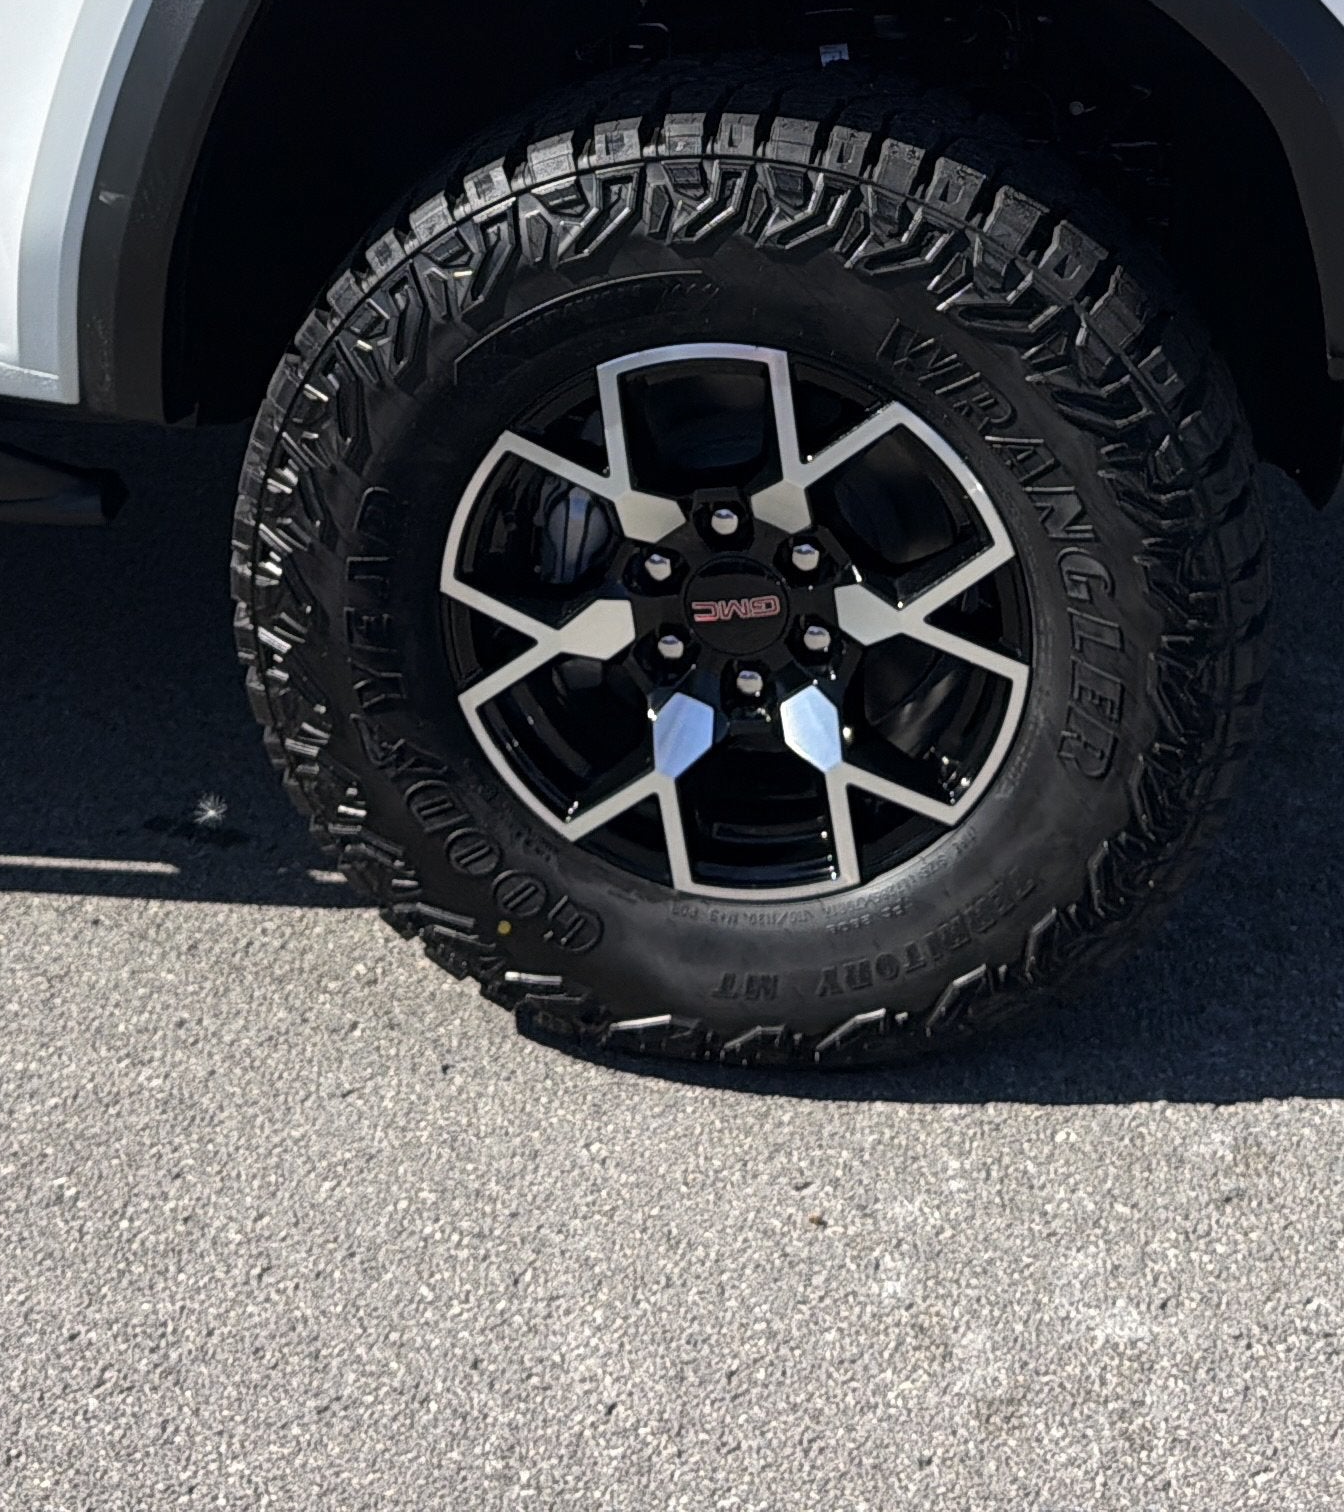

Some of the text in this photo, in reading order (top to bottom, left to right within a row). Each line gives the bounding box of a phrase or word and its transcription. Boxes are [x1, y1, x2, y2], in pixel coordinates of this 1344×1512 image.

[692, 595, 781, 622] GMC
[875, 317, 1125, 781] WRANGLER
[342, 486, 605, 954] GOODYEAR
[713, 972, 781, 1000] MT
